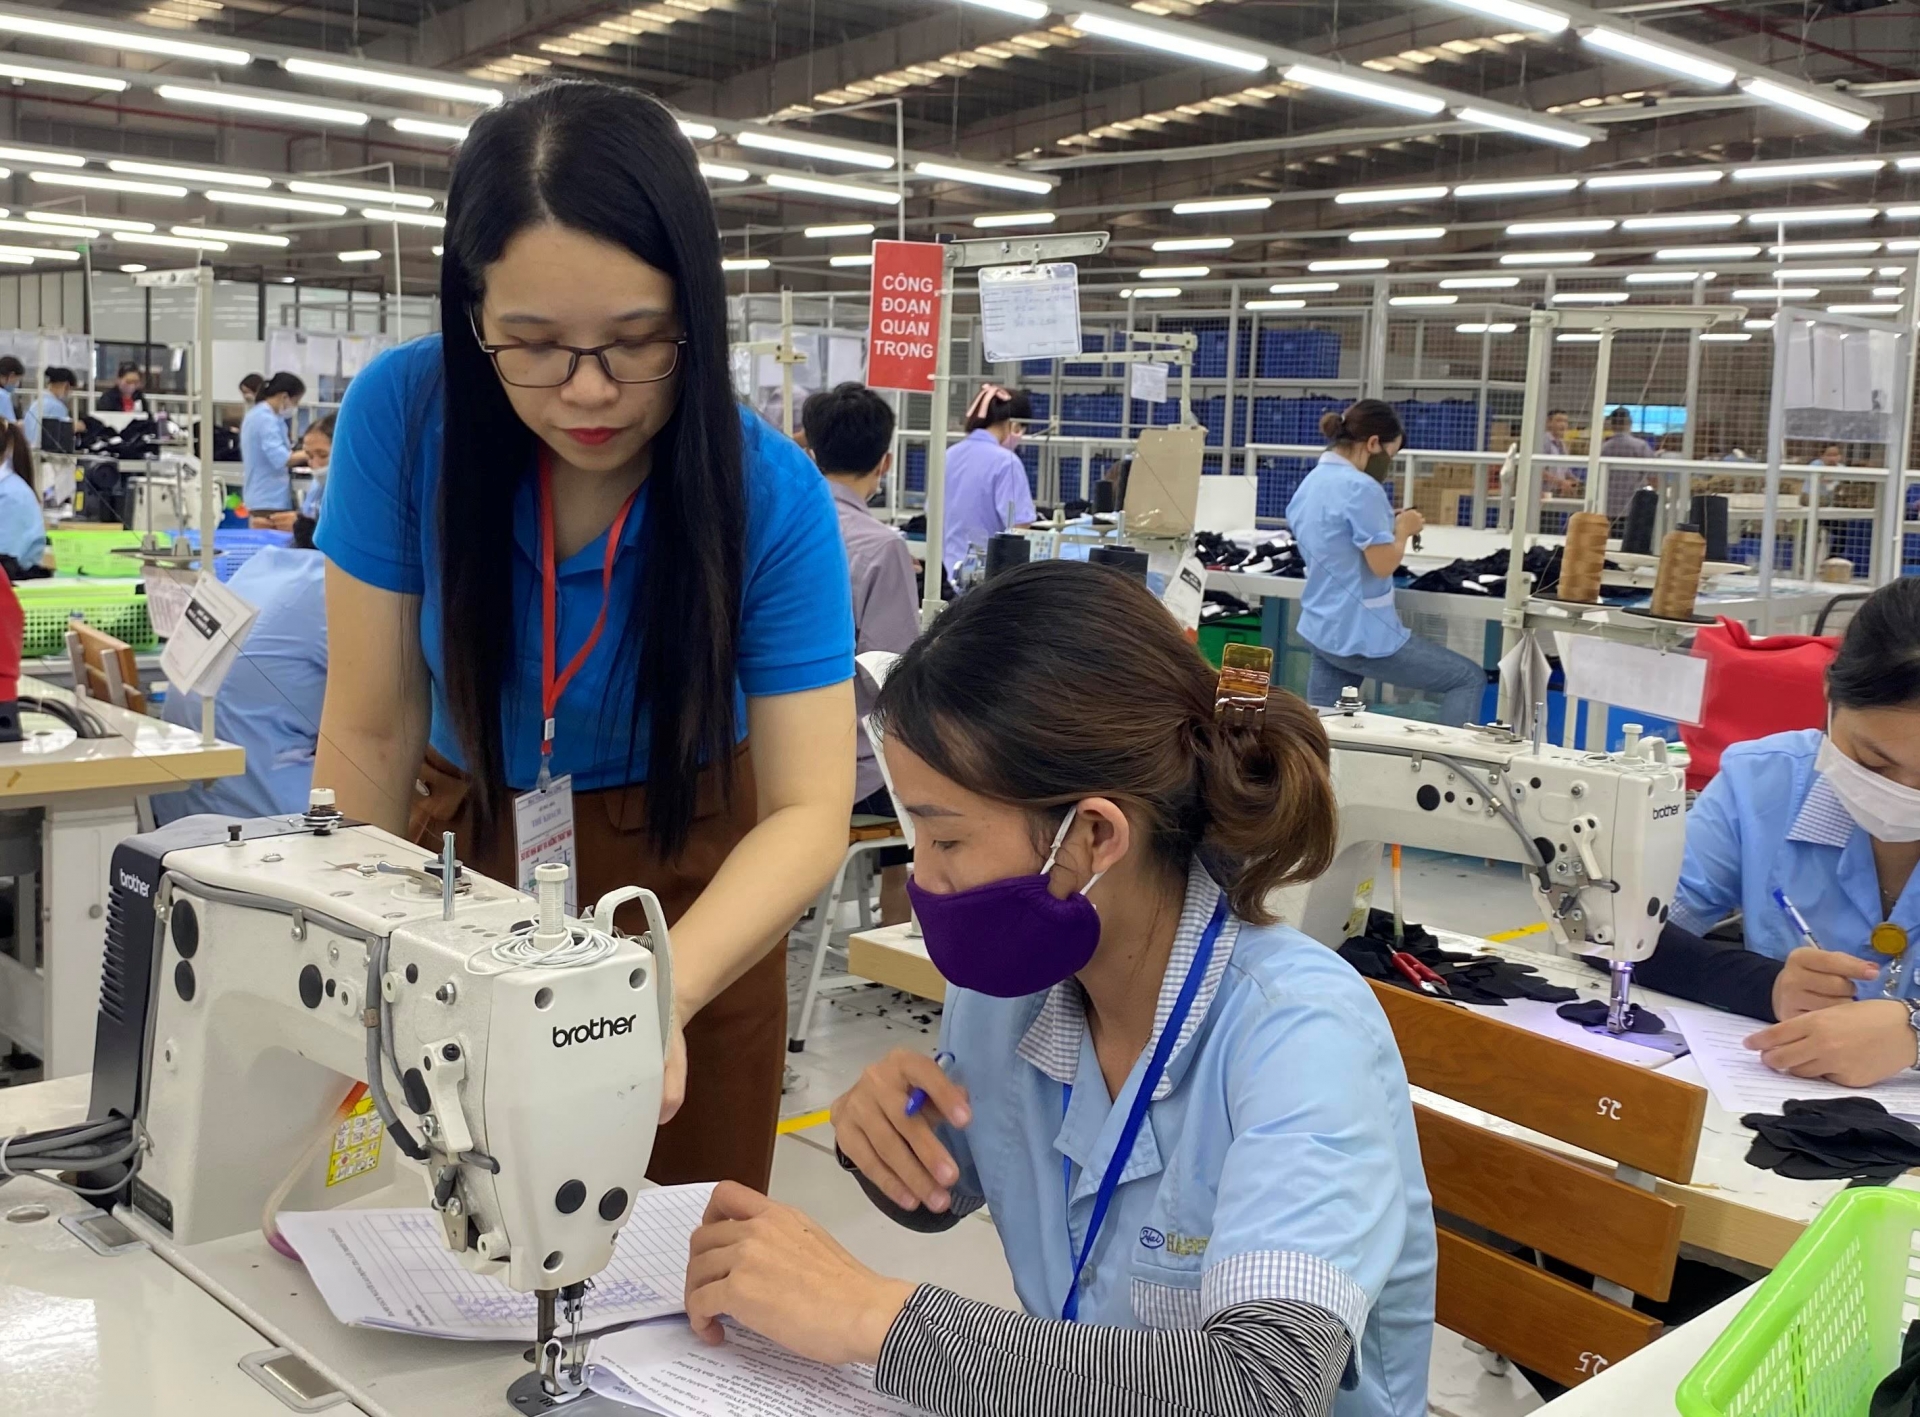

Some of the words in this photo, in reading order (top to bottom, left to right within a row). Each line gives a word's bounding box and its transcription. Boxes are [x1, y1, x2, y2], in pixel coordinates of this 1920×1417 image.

[882, 272, 933, 293] CÔNG
[881, 297, 931, 317] ĐOẠN
[880, 318, 930, 337] QUAN
[874, 340, 933, 360] TRỌNG
[1653, 804, 1680, 820] brother
[120, 868, 150, 898] brother
[552, 1013, 636, 1048] brother
[1596, 1096, 1622, 1121] 25
[1573, 1351, 1608, 1376] 25
